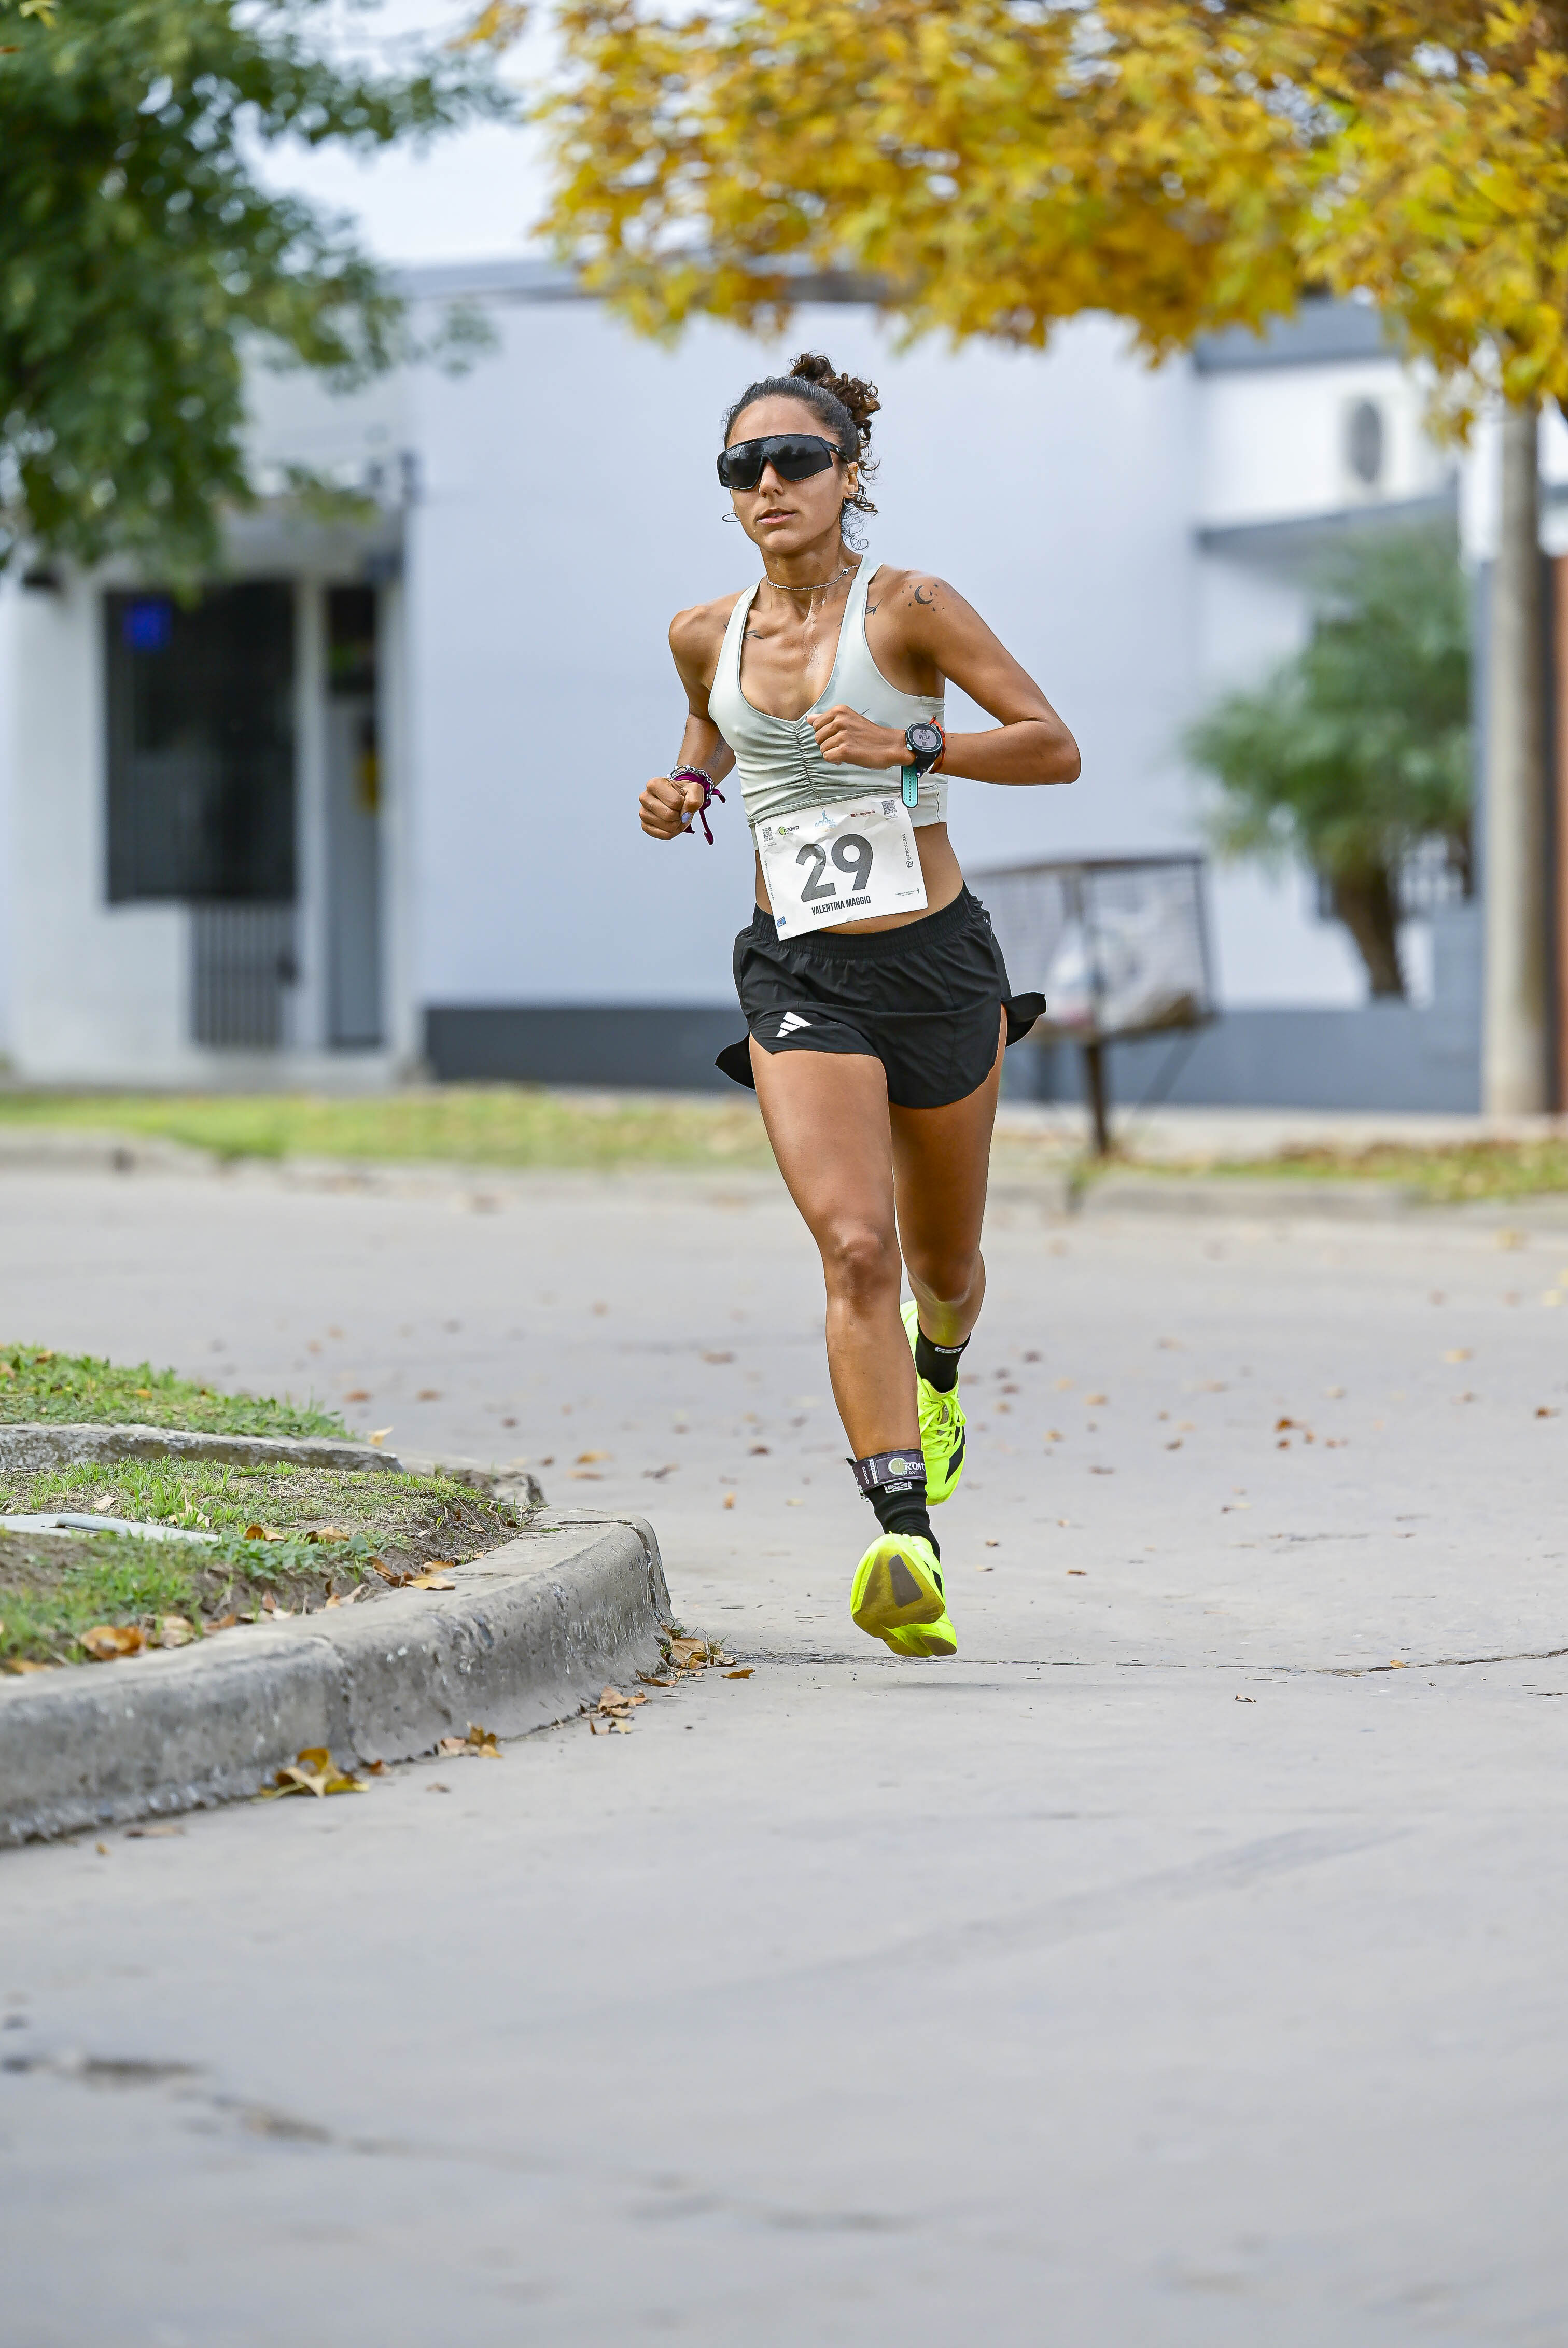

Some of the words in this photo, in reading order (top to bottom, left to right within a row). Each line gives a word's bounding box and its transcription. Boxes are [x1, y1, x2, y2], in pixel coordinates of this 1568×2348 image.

[902, 833, 911, 860] @CRONORAV
[796, 834, 873, 902] 29
[811, 900, 845, 915] VALENTINA
[845, 895, 871, 907] MAGGIO
